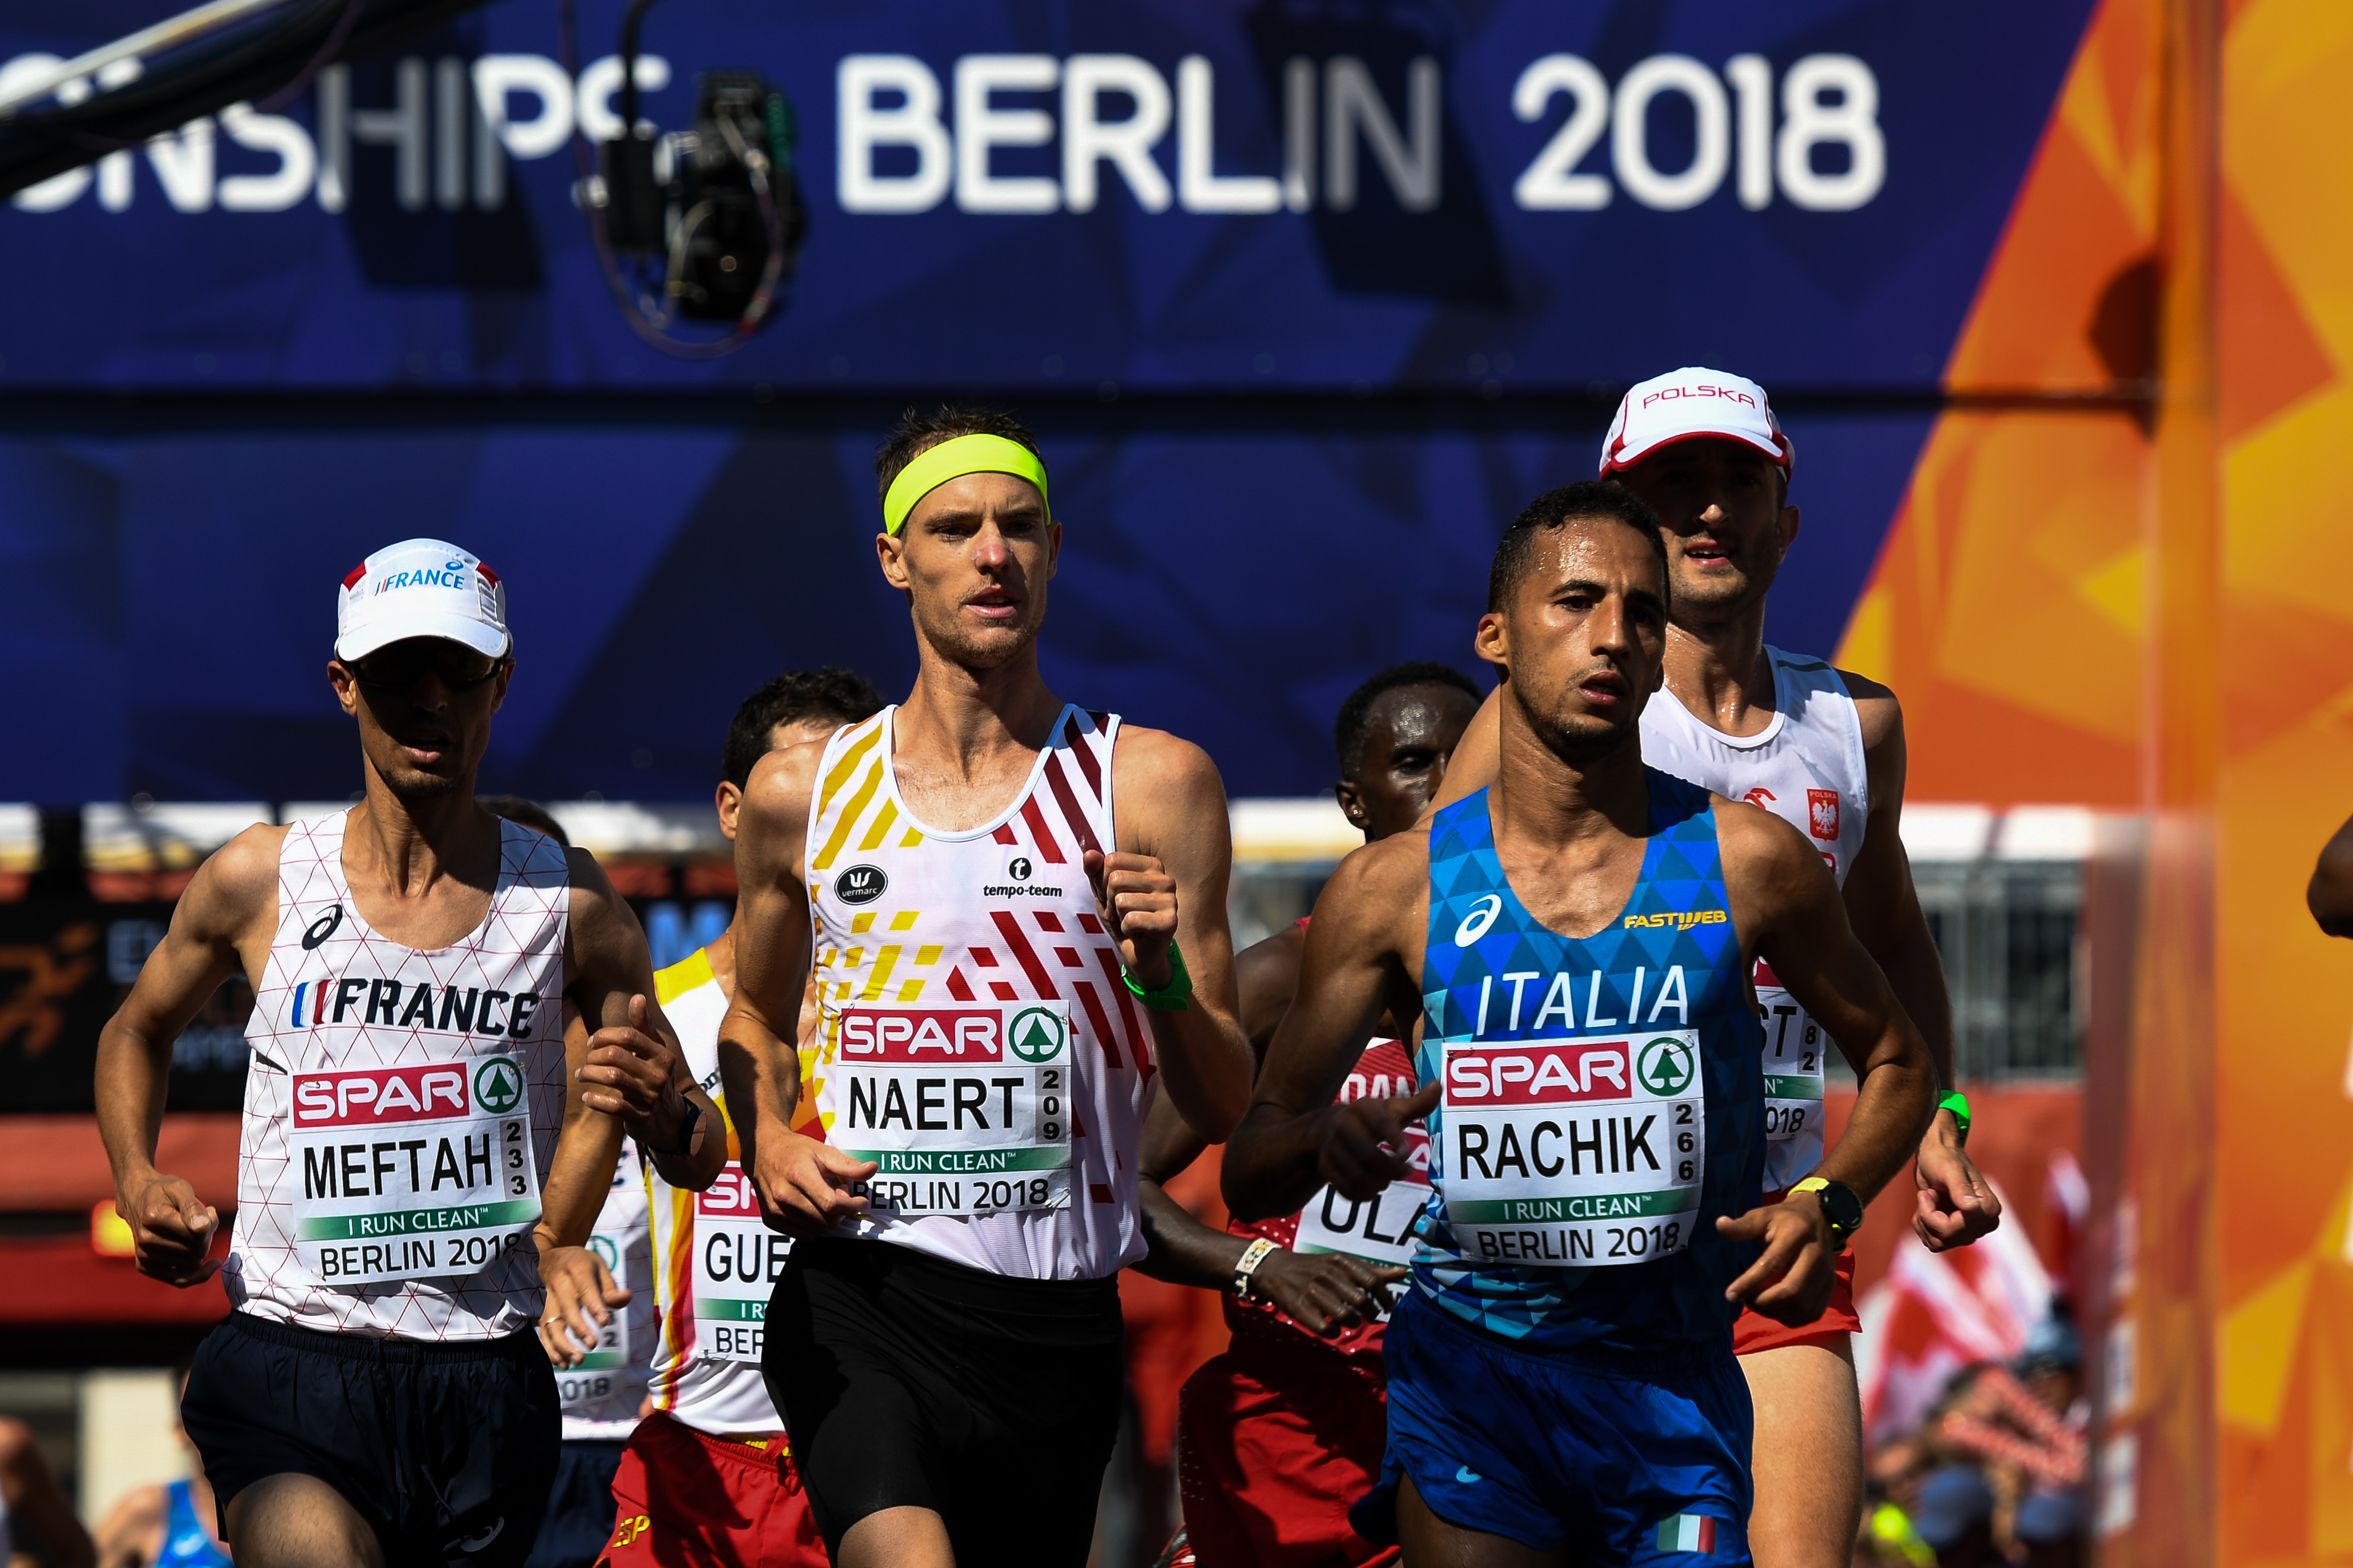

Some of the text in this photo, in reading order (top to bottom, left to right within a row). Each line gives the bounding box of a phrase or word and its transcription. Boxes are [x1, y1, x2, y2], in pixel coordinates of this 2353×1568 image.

[836, 53, 1442, 215] BERLIN
[1513, 53, 1887, 212] 2018
[1643, 385, 1756, 409] POLSKA
[384, 568, 465, 593] FRANCE
[1809, 790, 1837, 799] POLSKA
[842, 887, 878, 897] vermarc
[983, 883, 1063, 899] tempo-team
[1624, 910, 1727, 931] FASTWEB
[332, 977, 539, 1040] FRANCE
[1476, 964, 1688, 1036] ITALIA
[844, 1016, 998, 1055] SPAR
[1449, 1050, 1628, 1099] SPAR
[296, 1072, 465, 1121] SPAR
[849, 1076, 1024, 1131] NAERT
[303, 1132, 493, 1201] MEFTAH
[881, 1151, 885, 1169] I
[891, 1153, 933, 1171] RUN
[1459, 1114, 1661, 1181] RACHIK
[973, 1178, 1049, 1210] 2018
[1504, 1203, 1510, 1220] I
[1517, 1200, 1563, 1219] RUN
[348, 1219, 353, 1236] I
[361, 1212, 405, 1235] RUN
[1477, 1222, 1681, 1260] BERLIN 2018
[320, 1239, 436, 1277] BERLIN
